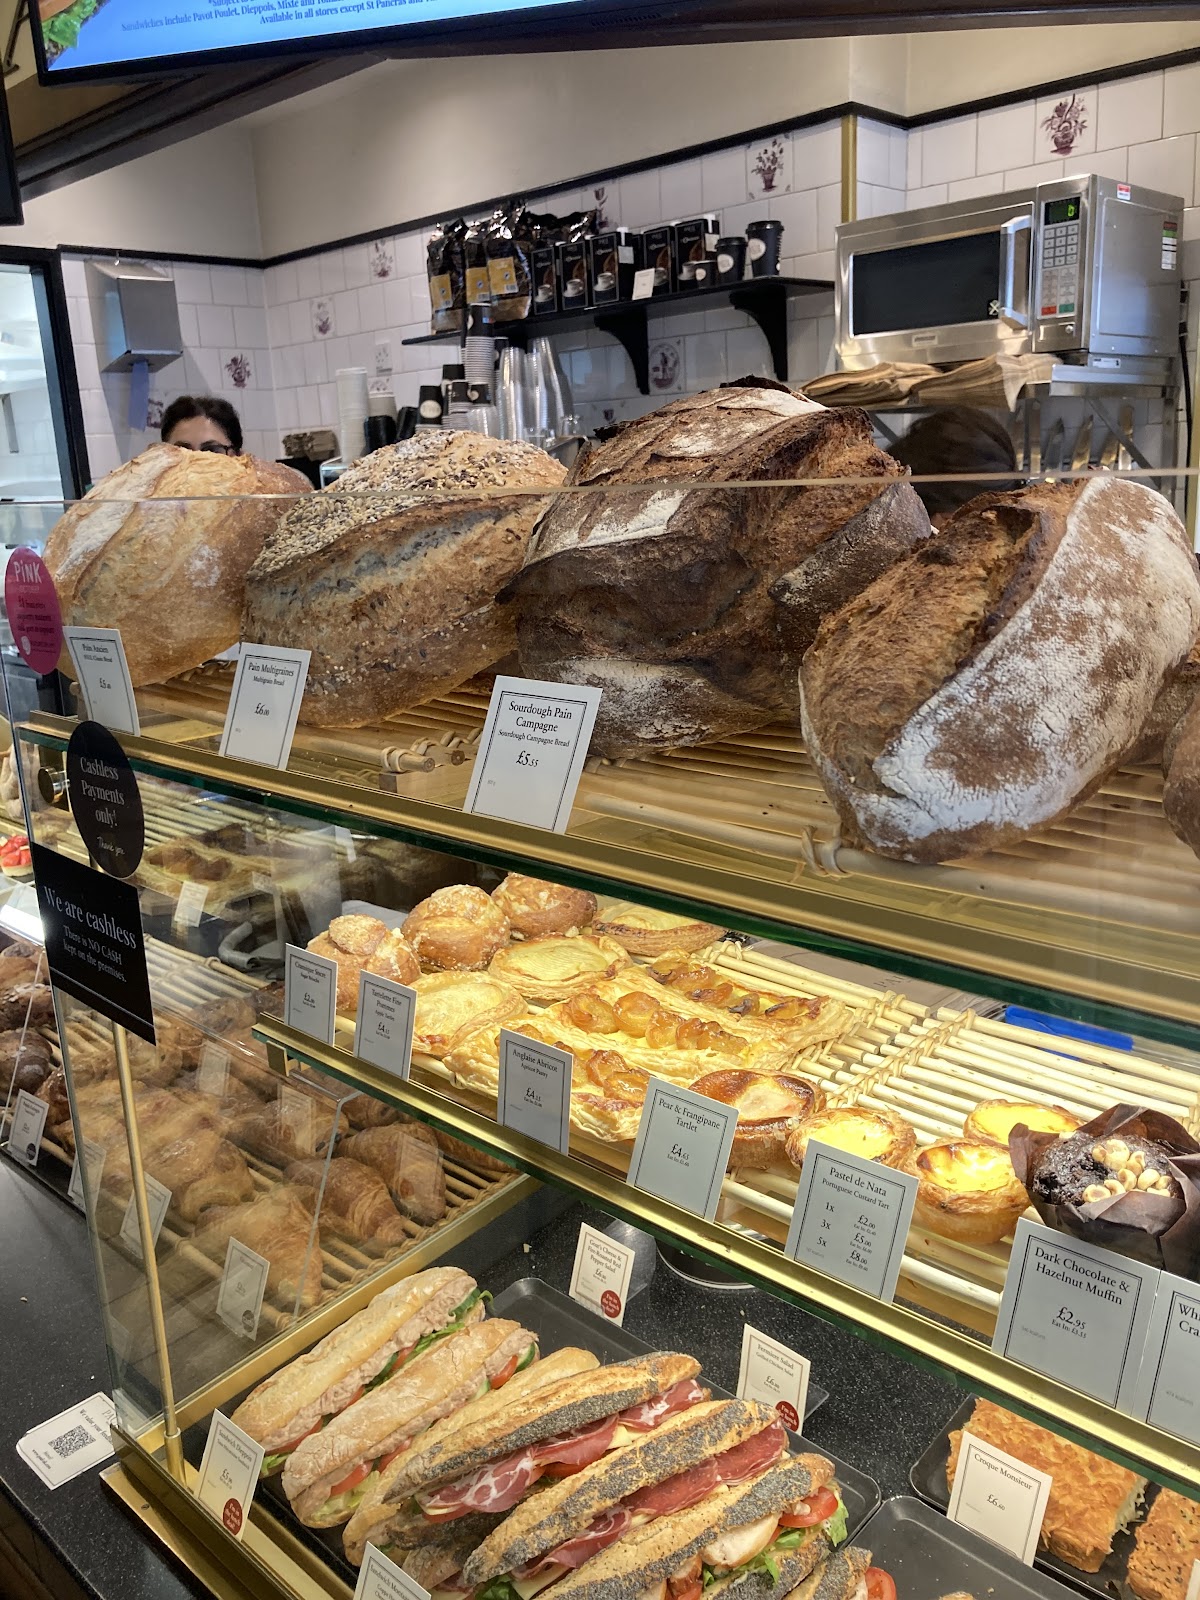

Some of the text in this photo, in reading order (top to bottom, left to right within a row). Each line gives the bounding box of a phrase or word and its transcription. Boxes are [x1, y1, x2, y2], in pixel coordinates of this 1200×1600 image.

[121, 19, 164, 31] Sandwiches
[164, 13, 192, 26] include
[193, 10, 214, 21] Pavot
[260, 10, 294, 24] Available
[295, 10, 303, 20] in
[304, 8, 314, 18] all
[316, 6, 338, 16] stores
[340, 3, 366, 14] except
[367, 0, 374, 9] St
[248, 662, 294, 677] Pain Multigraines
[254, 702, 270, 716] £6.00
[508, 701, 572, 720] Sourdough Pain
[516, 716, 558, 734] Campagne
[498, 730, 570, 748] Sourdough Campagne Bread
[80, 757, 120, 781] Cashless
[81, 780, 126, 806] Payments
[96, 808, 118, 828] only!
[44, 886, 137, 950] We are cashless
[62, 924, 122, 966] There is NO CASH
[62, 938, 127, 983] kept on the premises.
[513, 1049, 558, 1072] Anglaise Abricot
[658, 1098, 721, 1129] Pear & Frangipane
[676, 1117, 698, 1133] Tartlet
[670, 1144, 690, 1160] £4.65
[830, 1167, 887, 1197] Pastel de Nata
[822, 1178, 890, 1210] Portuguese Custard Tart
[826, 1202, 835, 1212] 1x
[821, 1219, 831, 1230] 3x
[858, 1215, 876, 1229] £2.00
[589, 1239, 602, 1253] Goat's
[603, 1247, 617, 1259] Cheese
[817, 1236, 828, 1247] 5x
[854, 1233, 871, 1247] £5.00
[588, 1246, 621, 1268] Fire-Roasted Red
[590, 1255, 615, 1273] Pepper Salad
[850, 1250, 867, 1265] £8.00
[1034, 1246, 1130, 1293] Dark Chocolate &
[1036, 1262, 1123, 1306] Hazelnut Muffin
[1056, 1306, 1086, 1330] £2.95
[1052, 1319, 1061, 1328] Eat
[1071, 1328, 1087, 1339] £3.55
[780, 1357, 794, 1369] Salad
[80, 1408, 86, 1416] We
[974, 1454, 1033, 1490] Croque Monsieur
[986, 1494, 1005, 1511] £6.60
